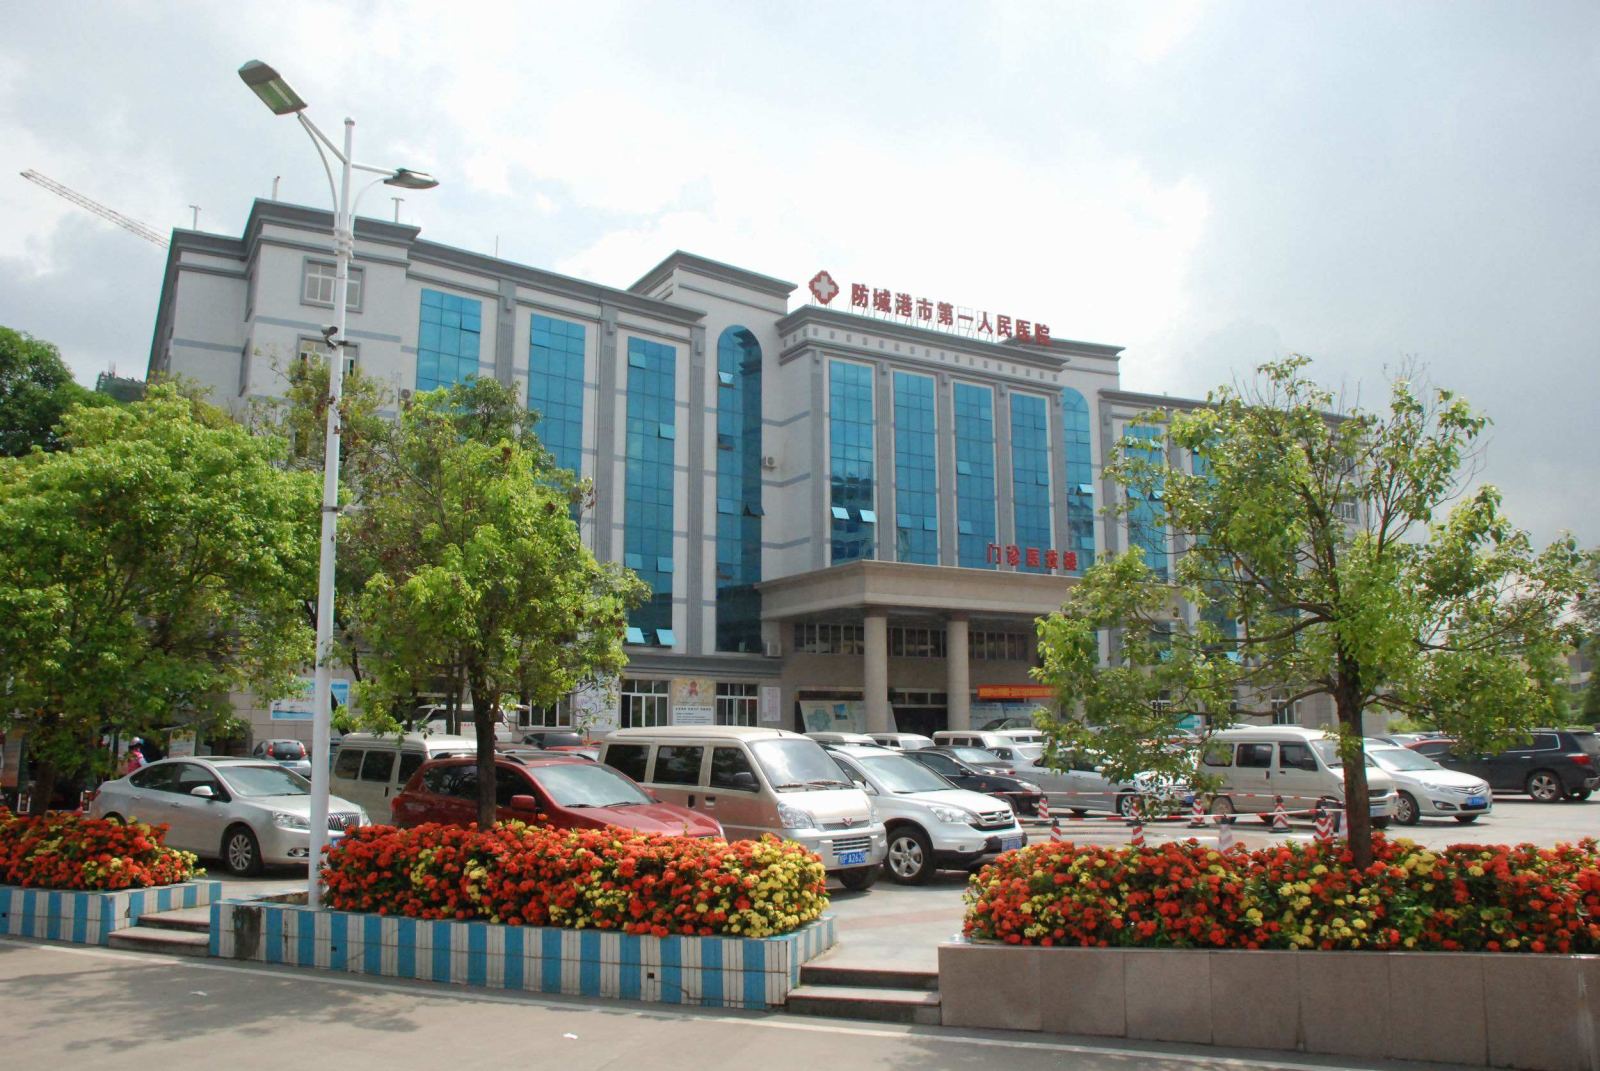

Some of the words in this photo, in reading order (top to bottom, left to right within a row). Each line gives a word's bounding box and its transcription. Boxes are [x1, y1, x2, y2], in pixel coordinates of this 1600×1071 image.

[851, 283, 1052, 346] 防城港市第一人民医院
